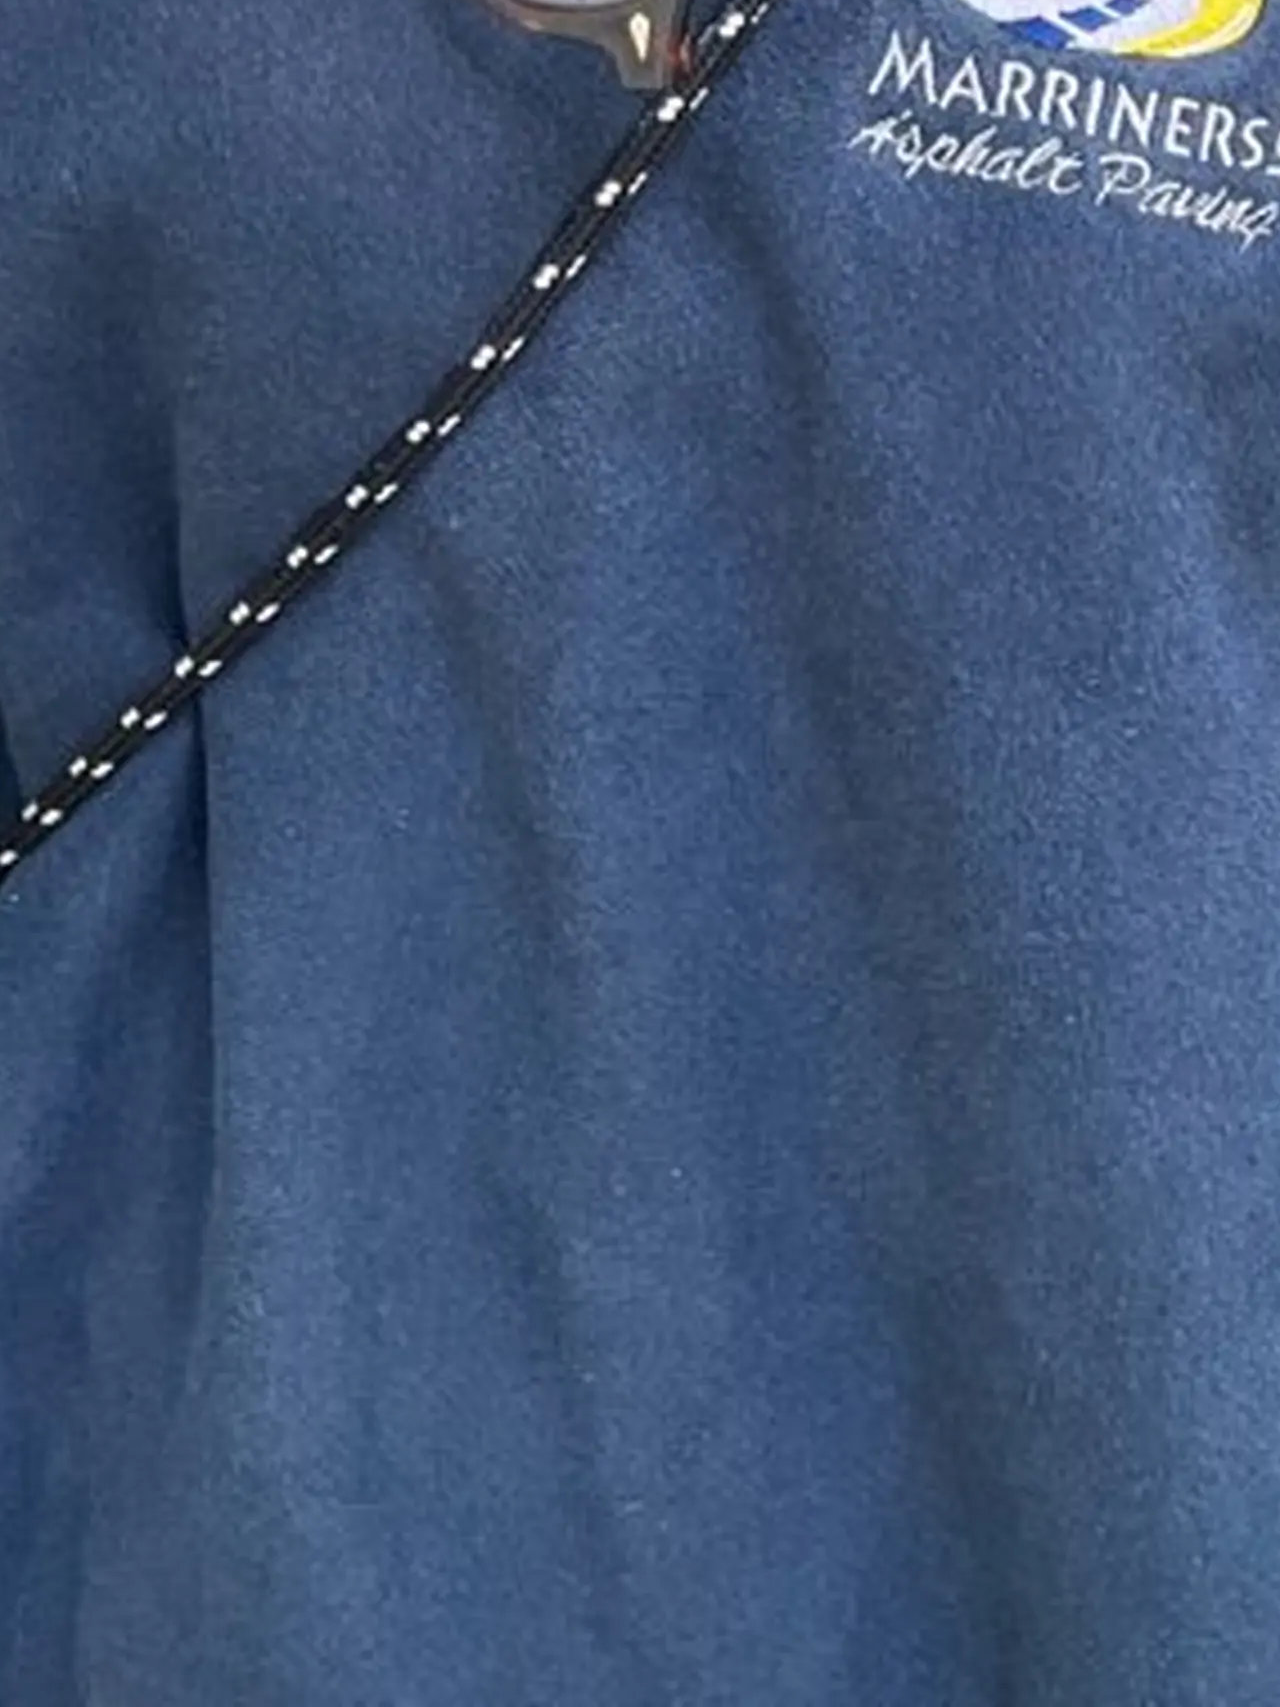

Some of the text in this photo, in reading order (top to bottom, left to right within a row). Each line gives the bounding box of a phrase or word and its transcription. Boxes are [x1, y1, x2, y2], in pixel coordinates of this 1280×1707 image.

[867, 28, 1269, 170] MARRINERS
[846, 108, 1280, 256] Asphalt Paving
